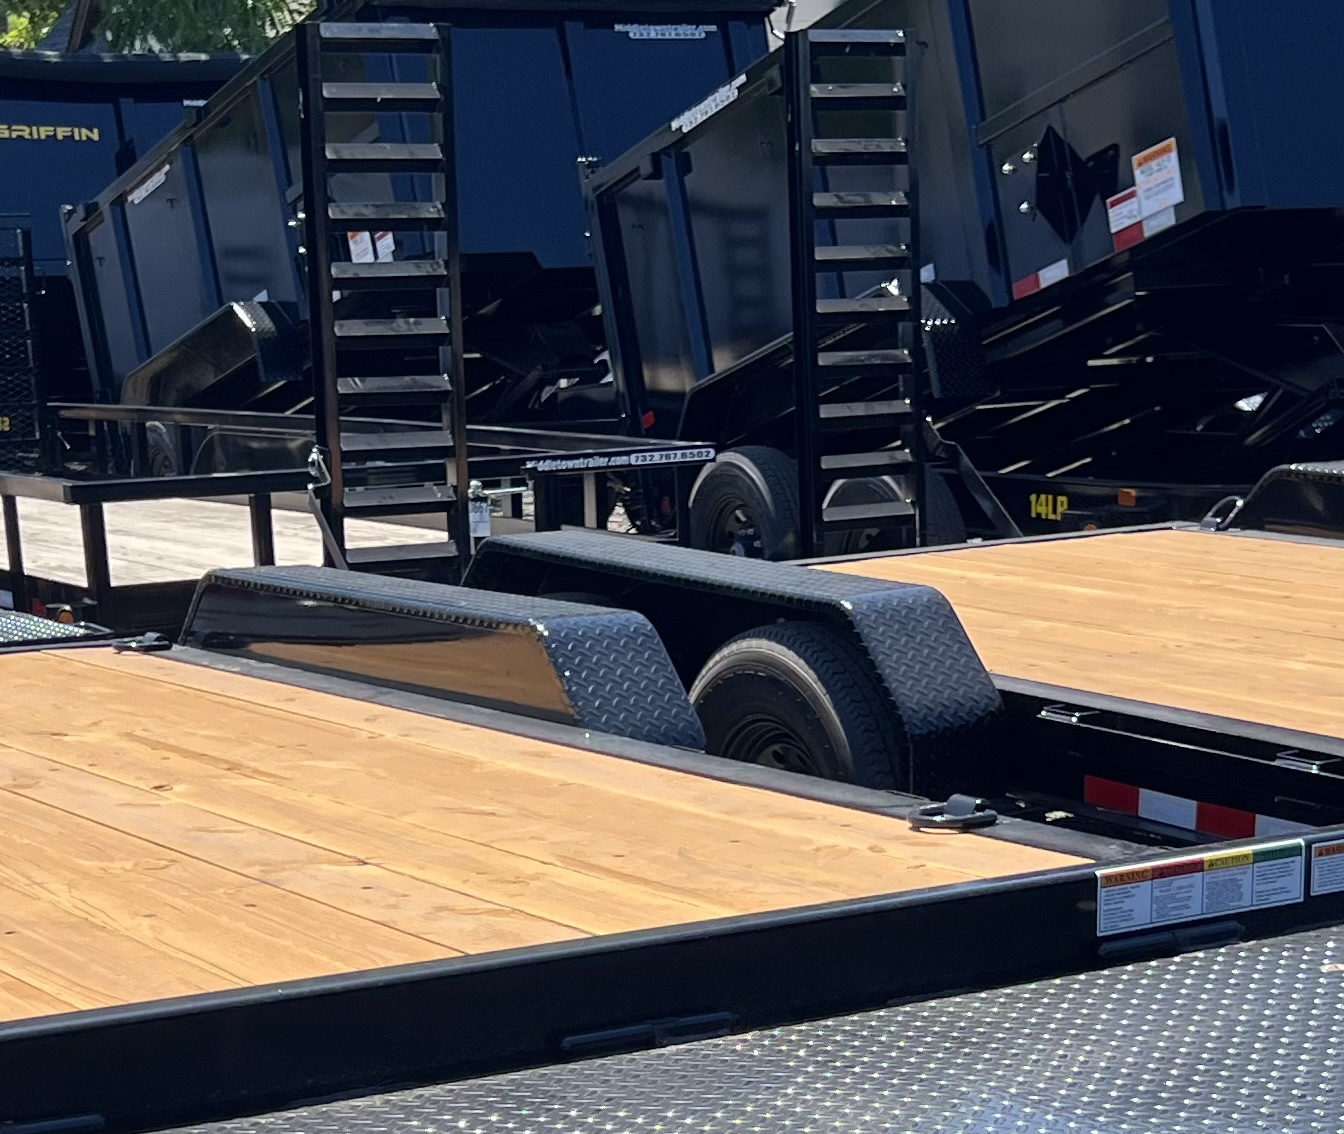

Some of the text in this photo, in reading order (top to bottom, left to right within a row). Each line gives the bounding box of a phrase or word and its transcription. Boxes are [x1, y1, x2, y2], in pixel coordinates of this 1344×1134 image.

[634, 450, 712, 463] 732.787.6502
[1029, 493, 1069, 521] 14LP
[1214, 854, 1249, 867] CAUTION
[1105, 871, 1148, 884] WARNING
